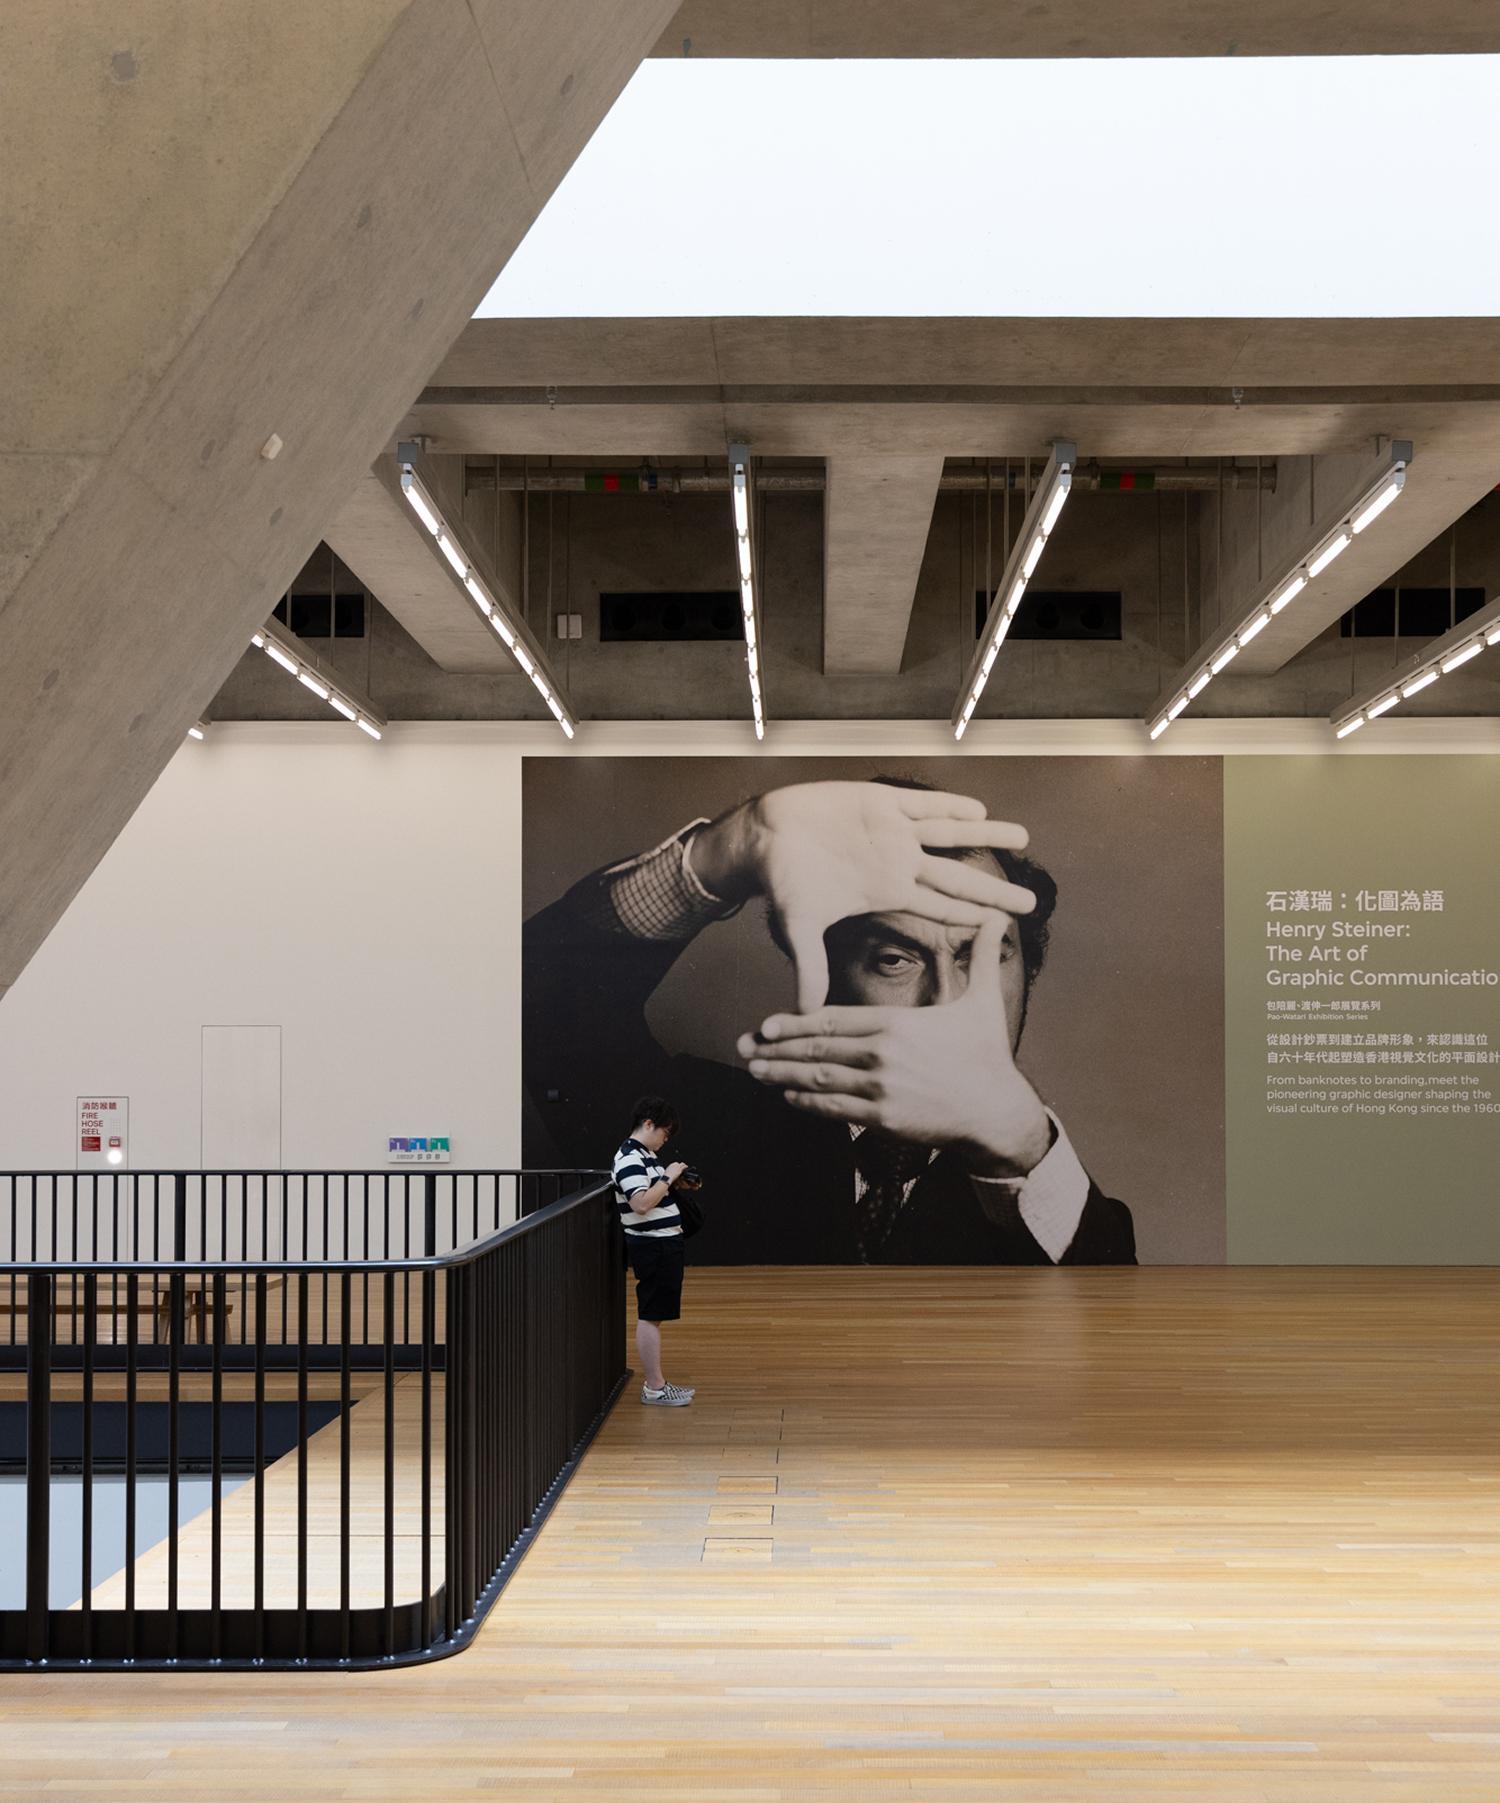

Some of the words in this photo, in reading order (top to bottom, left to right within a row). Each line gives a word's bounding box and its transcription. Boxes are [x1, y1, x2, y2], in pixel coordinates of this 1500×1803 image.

[1266, 921, 1326, 941] Henry
[1332, 921, 1411, 937] Steiner:
[1266, 945, 1303, 961] The
[1309, 945, 1341, 962] Art
[1347, 944, 1368, 962] of
[1266, 969, 1344, 989] Graphic
[1350, 969, 1499, 986] Communicatio
[1266, 1075, 1296, 1085] From
[1298, 1074, 1358, 1085] banknotes
[1360, 1075, 1372, 1085] to
[1428, 1075, 1459, 1085] meet
[1460, 1074, 1480, 1085] the
[1267, 1089, 1327, 1101] pioneering
[1329, 1089, 1371, 1101] graphic
[1373, 1089, 1423, 1101] designer
[1425, 1089, 1469, 1101] shaping
[1472, 1089, 1492, 1099] the
[1266, 1103, 1298, 1113] visual
[1300, 1103, 1340, 1113] culture
[1341, 1103, 1355, 1113] of
[1356, 1104, 1386, 1115] Hong
[1388, 1104, 1418, 1115] Kong
[1420, 1103, 1450, 1113] since
[1451, 1103, 1471, 1113] the
